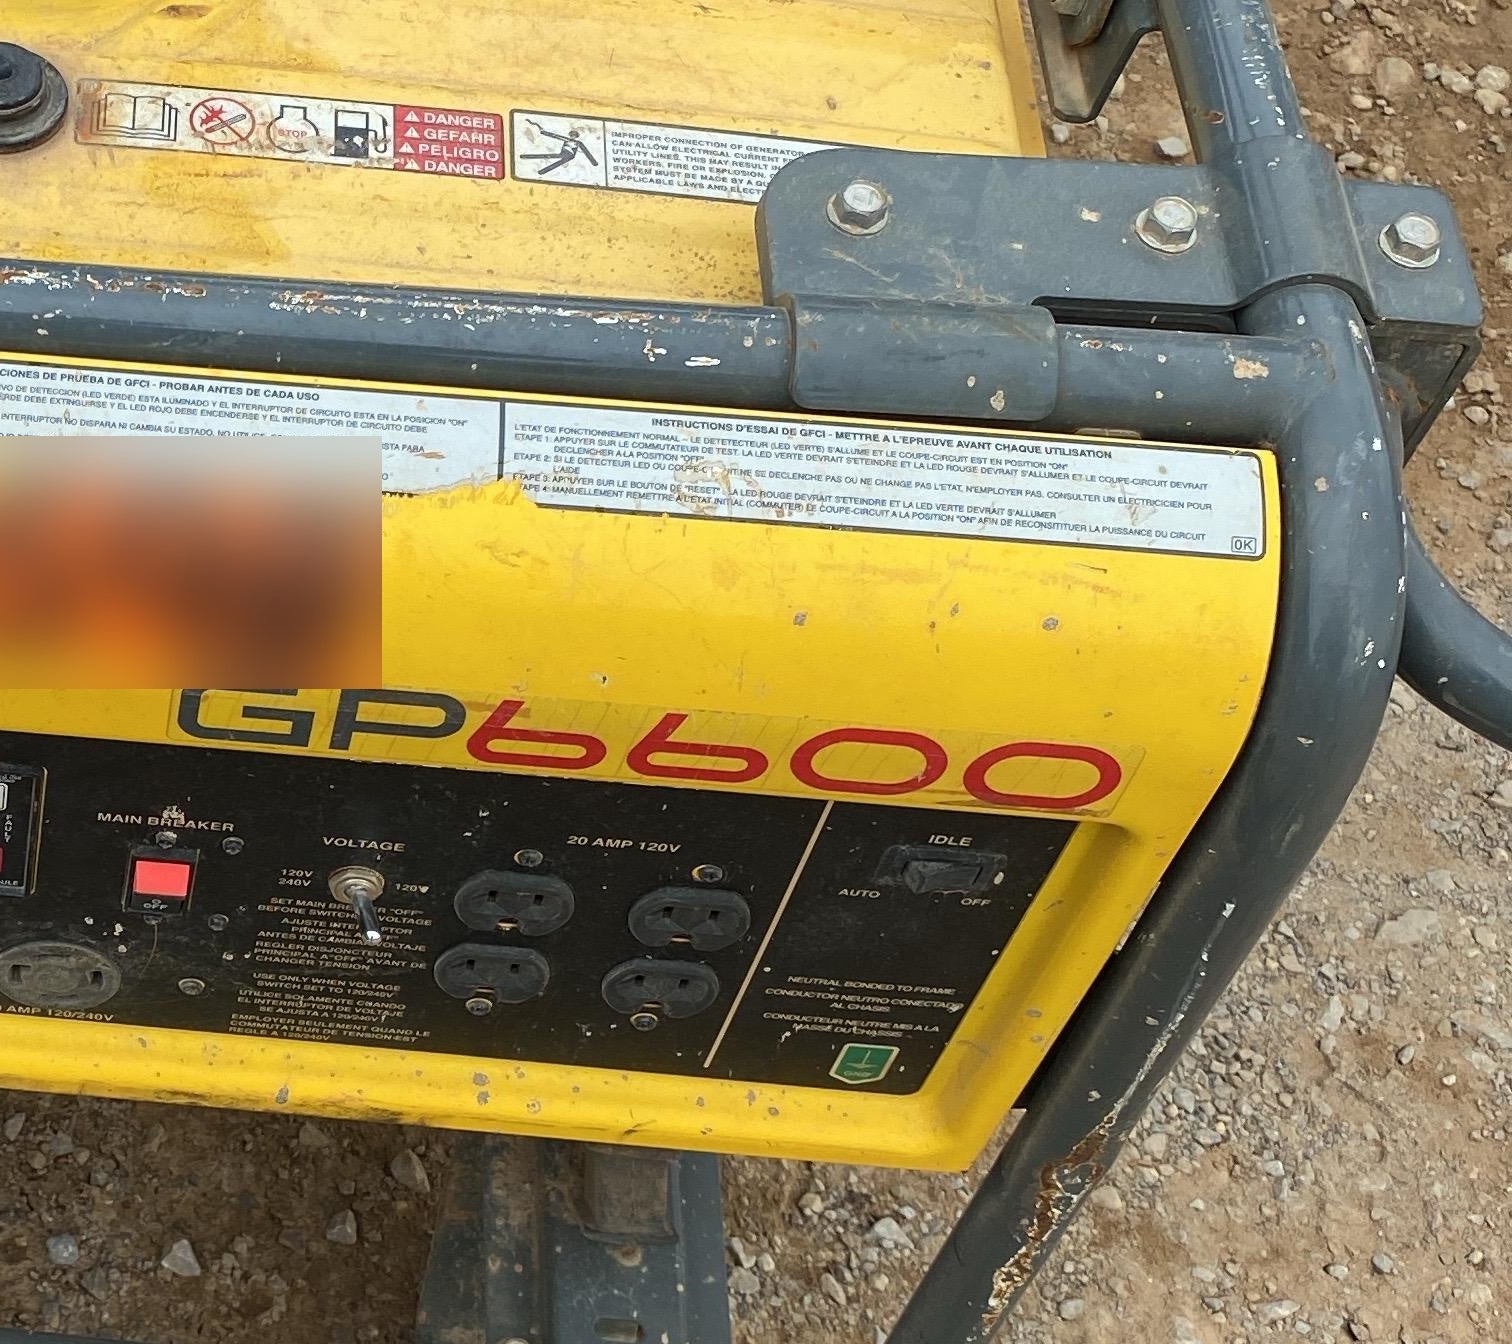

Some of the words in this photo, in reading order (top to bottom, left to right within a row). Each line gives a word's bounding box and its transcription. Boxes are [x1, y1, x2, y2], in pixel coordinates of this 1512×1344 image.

[423, 112, 495, 130] DANGER
[277, 127, 308, 139] STOP
[423, 127, 495, 146] GEFAHR
[418, 143, 499, 162] PELIGRO
[424, 159, 496, 178] DANGER
[43, 372, 57, 381] DE
[60, 373, 105, 384] PRUEBA
[107, 377, 122, 386] DE
[125, 378, 150, 388] GFCI
[159, 381, 205, 392] PROBAR
[208, 385, 243, 395] ANTES
[246, 388, 261, 397] DE
[264, 389, 294, 399] CADA
[297, 392, 320, 401] USO
[652, 418, 733, 432] INSTRUCTIONS
[736, 424, 779, 435] D'ESSAI
[782, 427, 797, 436] DE
[800, 428, 826, 438] GFCI
[835, 431, 880, 442] METTRE
[883, 434, 890, 443] A
[893, 435, 954, 448] L'EPREUVE
[957, 440, 992, 450] AVANT
[995, 442, 1042, 454] CHAQUE
[1045, 446, 1112, 459] UTILISATION
[177, 689, 1122, 809] GP6600
[4, 813, 13, 843] FAULT
[97, 811, 142, 826] MAIN
[147, 816, 235, 833] BREAKER
[322, 835, 407, 853] VOLTAGE
[567, 834, 587, 847] 20
[591, 837, 633, 852] AMP
[637, 840, 682, 855] 120V
[928, 834, 974, 848] IDLE
[278, 877, 312, 888] 240V
[280, 868, 314, 879] 120V
[838, 887, 881, 900] AUTO
[960, 896, 991, 909] OFF
[143, 901, 168, 910] OFF
[787, 975, 841, 988] NEUTRAL
[843, 980, 895, 992] BONDED
[897, 985, 914, 993] TO
[913, 986, 957, 996] FRAME
[764, 987, 840, 1001] CONDUCTOR
[840, 993, 889, 1005] NEUTRO
[10, 1004, 43, 1017] AMP
[45, 1007, 116, 1022] 120/240V
[830, 1002, 844, 1010] AL
[844, 1003, 891, 1014] CHASIS
